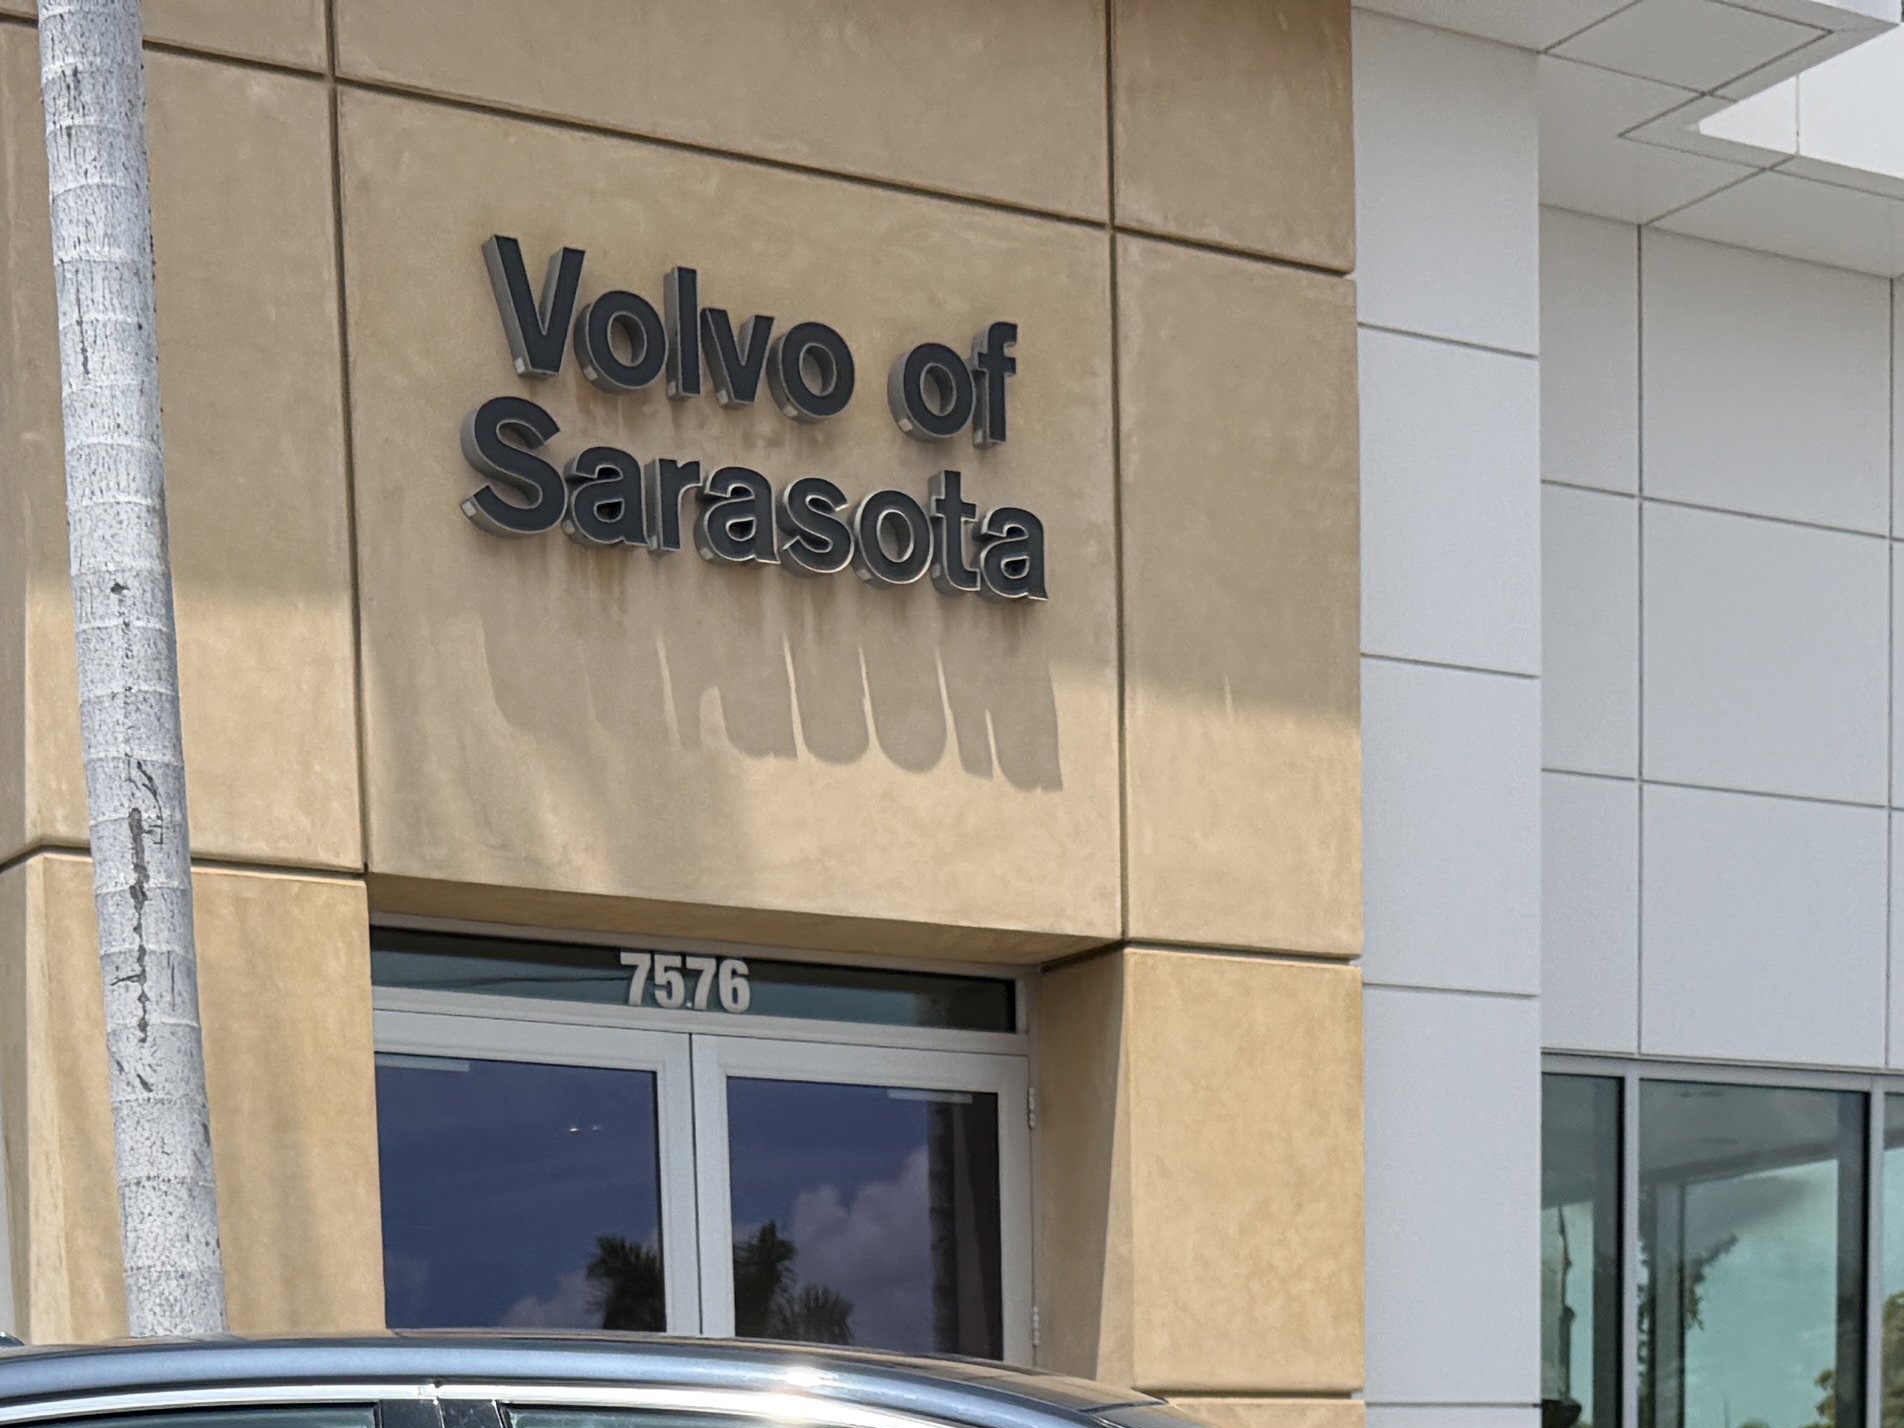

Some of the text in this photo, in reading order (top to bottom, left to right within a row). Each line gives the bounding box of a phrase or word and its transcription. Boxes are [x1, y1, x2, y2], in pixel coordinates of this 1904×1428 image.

[481, 234, 1018, 448] Volvo of
[460, 396, 1049, 602] Sarasota
[619, 952, 751, 1014] 7576
